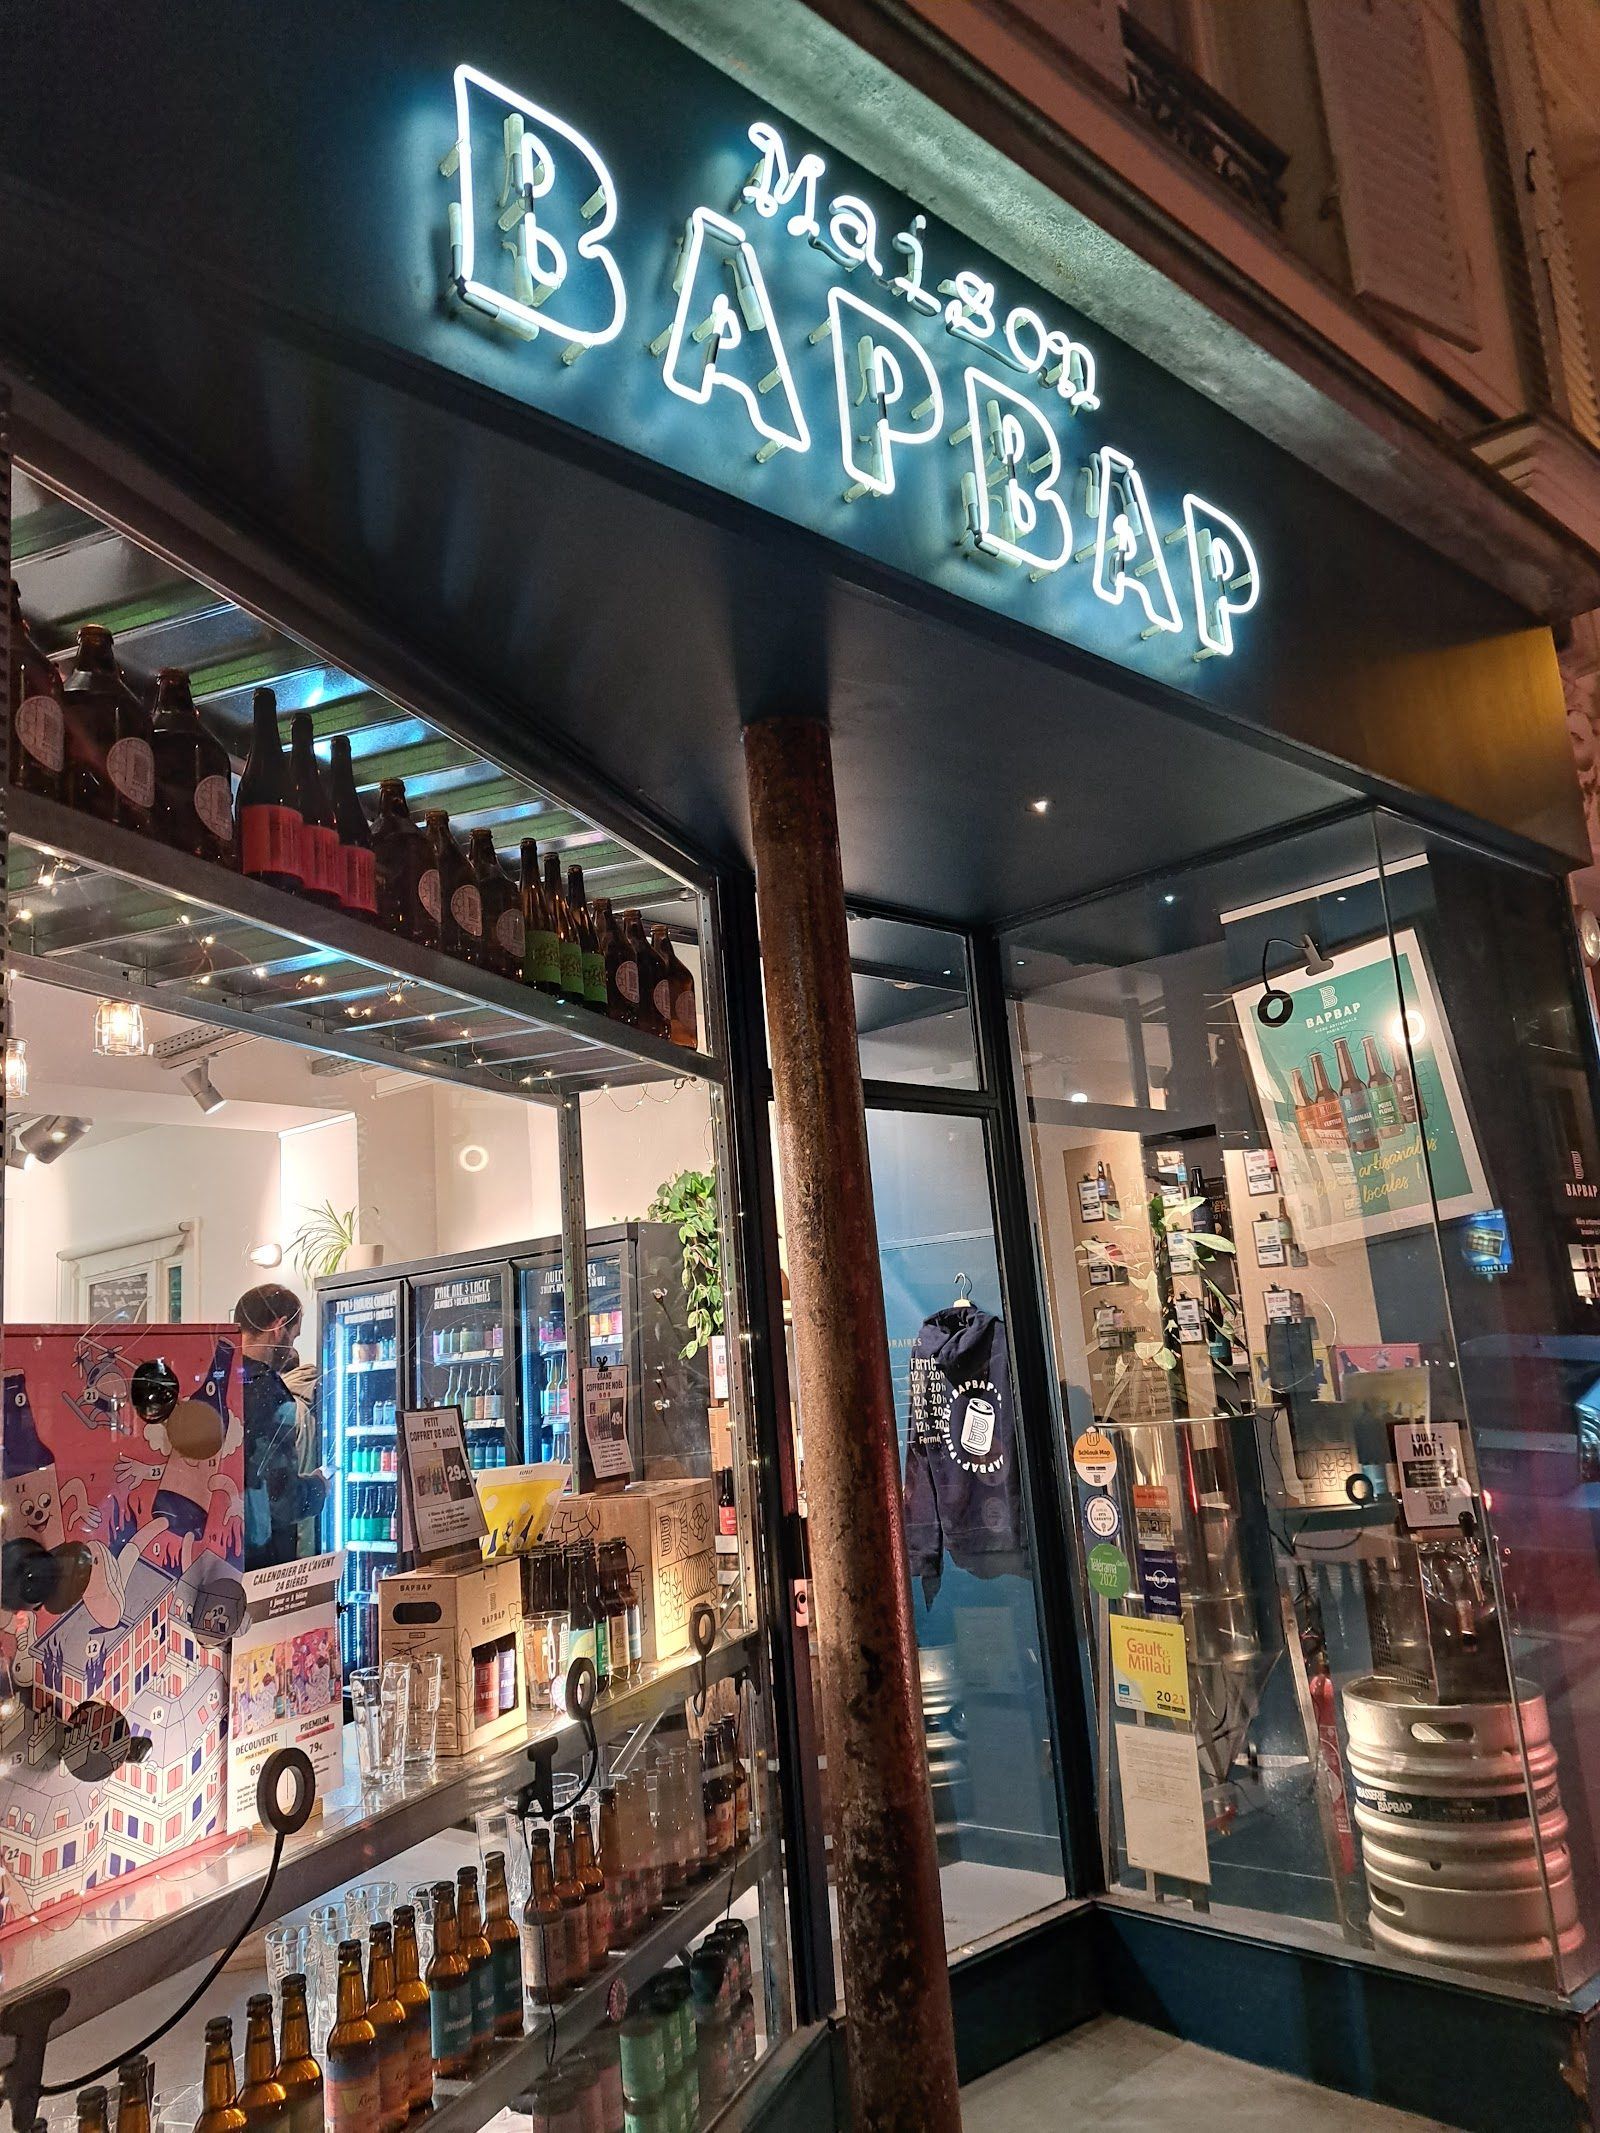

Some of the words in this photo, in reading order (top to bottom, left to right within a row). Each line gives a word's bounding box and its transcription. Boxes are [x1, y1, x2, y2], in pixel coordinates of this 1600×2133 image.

[742, 120, 1101, 412] Maison
[453, 63, 1261, 656] BAPBAP
[1305, 1002, 1361, 1029] BAPBAP
[1378, 1105, 1394, 1116] PLUME
[1358, 1135, 1438, 1178] artisanals
[1362, 1172, 1409, 1203] locales
[1565, 1183, 1598, 1198] BAPBAP
[910, 1354, 937, 1371] Fermé
[597, 1372, 612, 1381] GRAND
[208, 1384, 214, 1393] 8
[586, 1382, 605, 1392] COFFRET
[605, 1382, 612, 1390] DE
[611, 1379, 624, 1390] NOËL
[951, 1379, 994, 1400] BAPBAP
[18, 1395, 23, 1404] 3
[86, 1391, 96, 1400] 21
[423, 1417, 439, 1428] PETIT
[409, 1429, 435, 1442] COFFRET
[435, 1430, 442, 1439] DE
[442, 1425, 457, 1438] NOËL
[918, 1433, 941, 1445] Fermé
[1099, 1449, 1111, 1457] Map
[208, 1459, 216, 1467] 13
[90, 1473, 95, 1481] 7
[151, 1468, 161, 1476] 23
[446, 1464, 467, 1482] 29€
[15, 1484, 26, 1493] 11
[154, 1545, 159, 1553] 1
[253, 1565, 298, 1586] CALENDRIER
[297, 1562, 308, 1575] DE
[308, 1556, 336, 1572] L'AVENT
[1090, 1557, 1117, 1574] Télérama
[1099, 1572, 1118, 1588] 2022
[1144, 1574, 1160, 1584] lonely
[1160, 1576, 1176, 1584] planet
[275, 1581, 284, 1593] 24
[400, 1584, 432, 1592] BAPBAP
[213, 1606, 224, 1617] 20
[481, 1610, 505, 1625] BAPBAP
[153, 1629, 159, 1639] 9
[87, 1644, 98, 1654] 12
[1126, 1638, 1162, 1658] Gault
[15, 1663, 21, 1673] 6
[1128, 1654, 1171, 1676] Millau
[209, 1692, 218, 1702] 24
[1156, 1690, 1186, 1706] 2021
[152, 1709, 162, 1719] 18
[300, 1714, 330, 1733] PREMIUM
[92, 1740, 99, 1751] 2
[235, 1732, 279, 1756] DÉCOUVERTE
[309, 1741, 323, 1755] 79€
[11, 1754, 22, 1766] 15
[250, 1763, 261, 1776] 69
[210, 1773, 218, 1782] 17
[1376, 1801, 1413, 1814] BAPBAP
[84, 1821, 94, 1832] 16
[7, 1848, 20, 1860] 22
